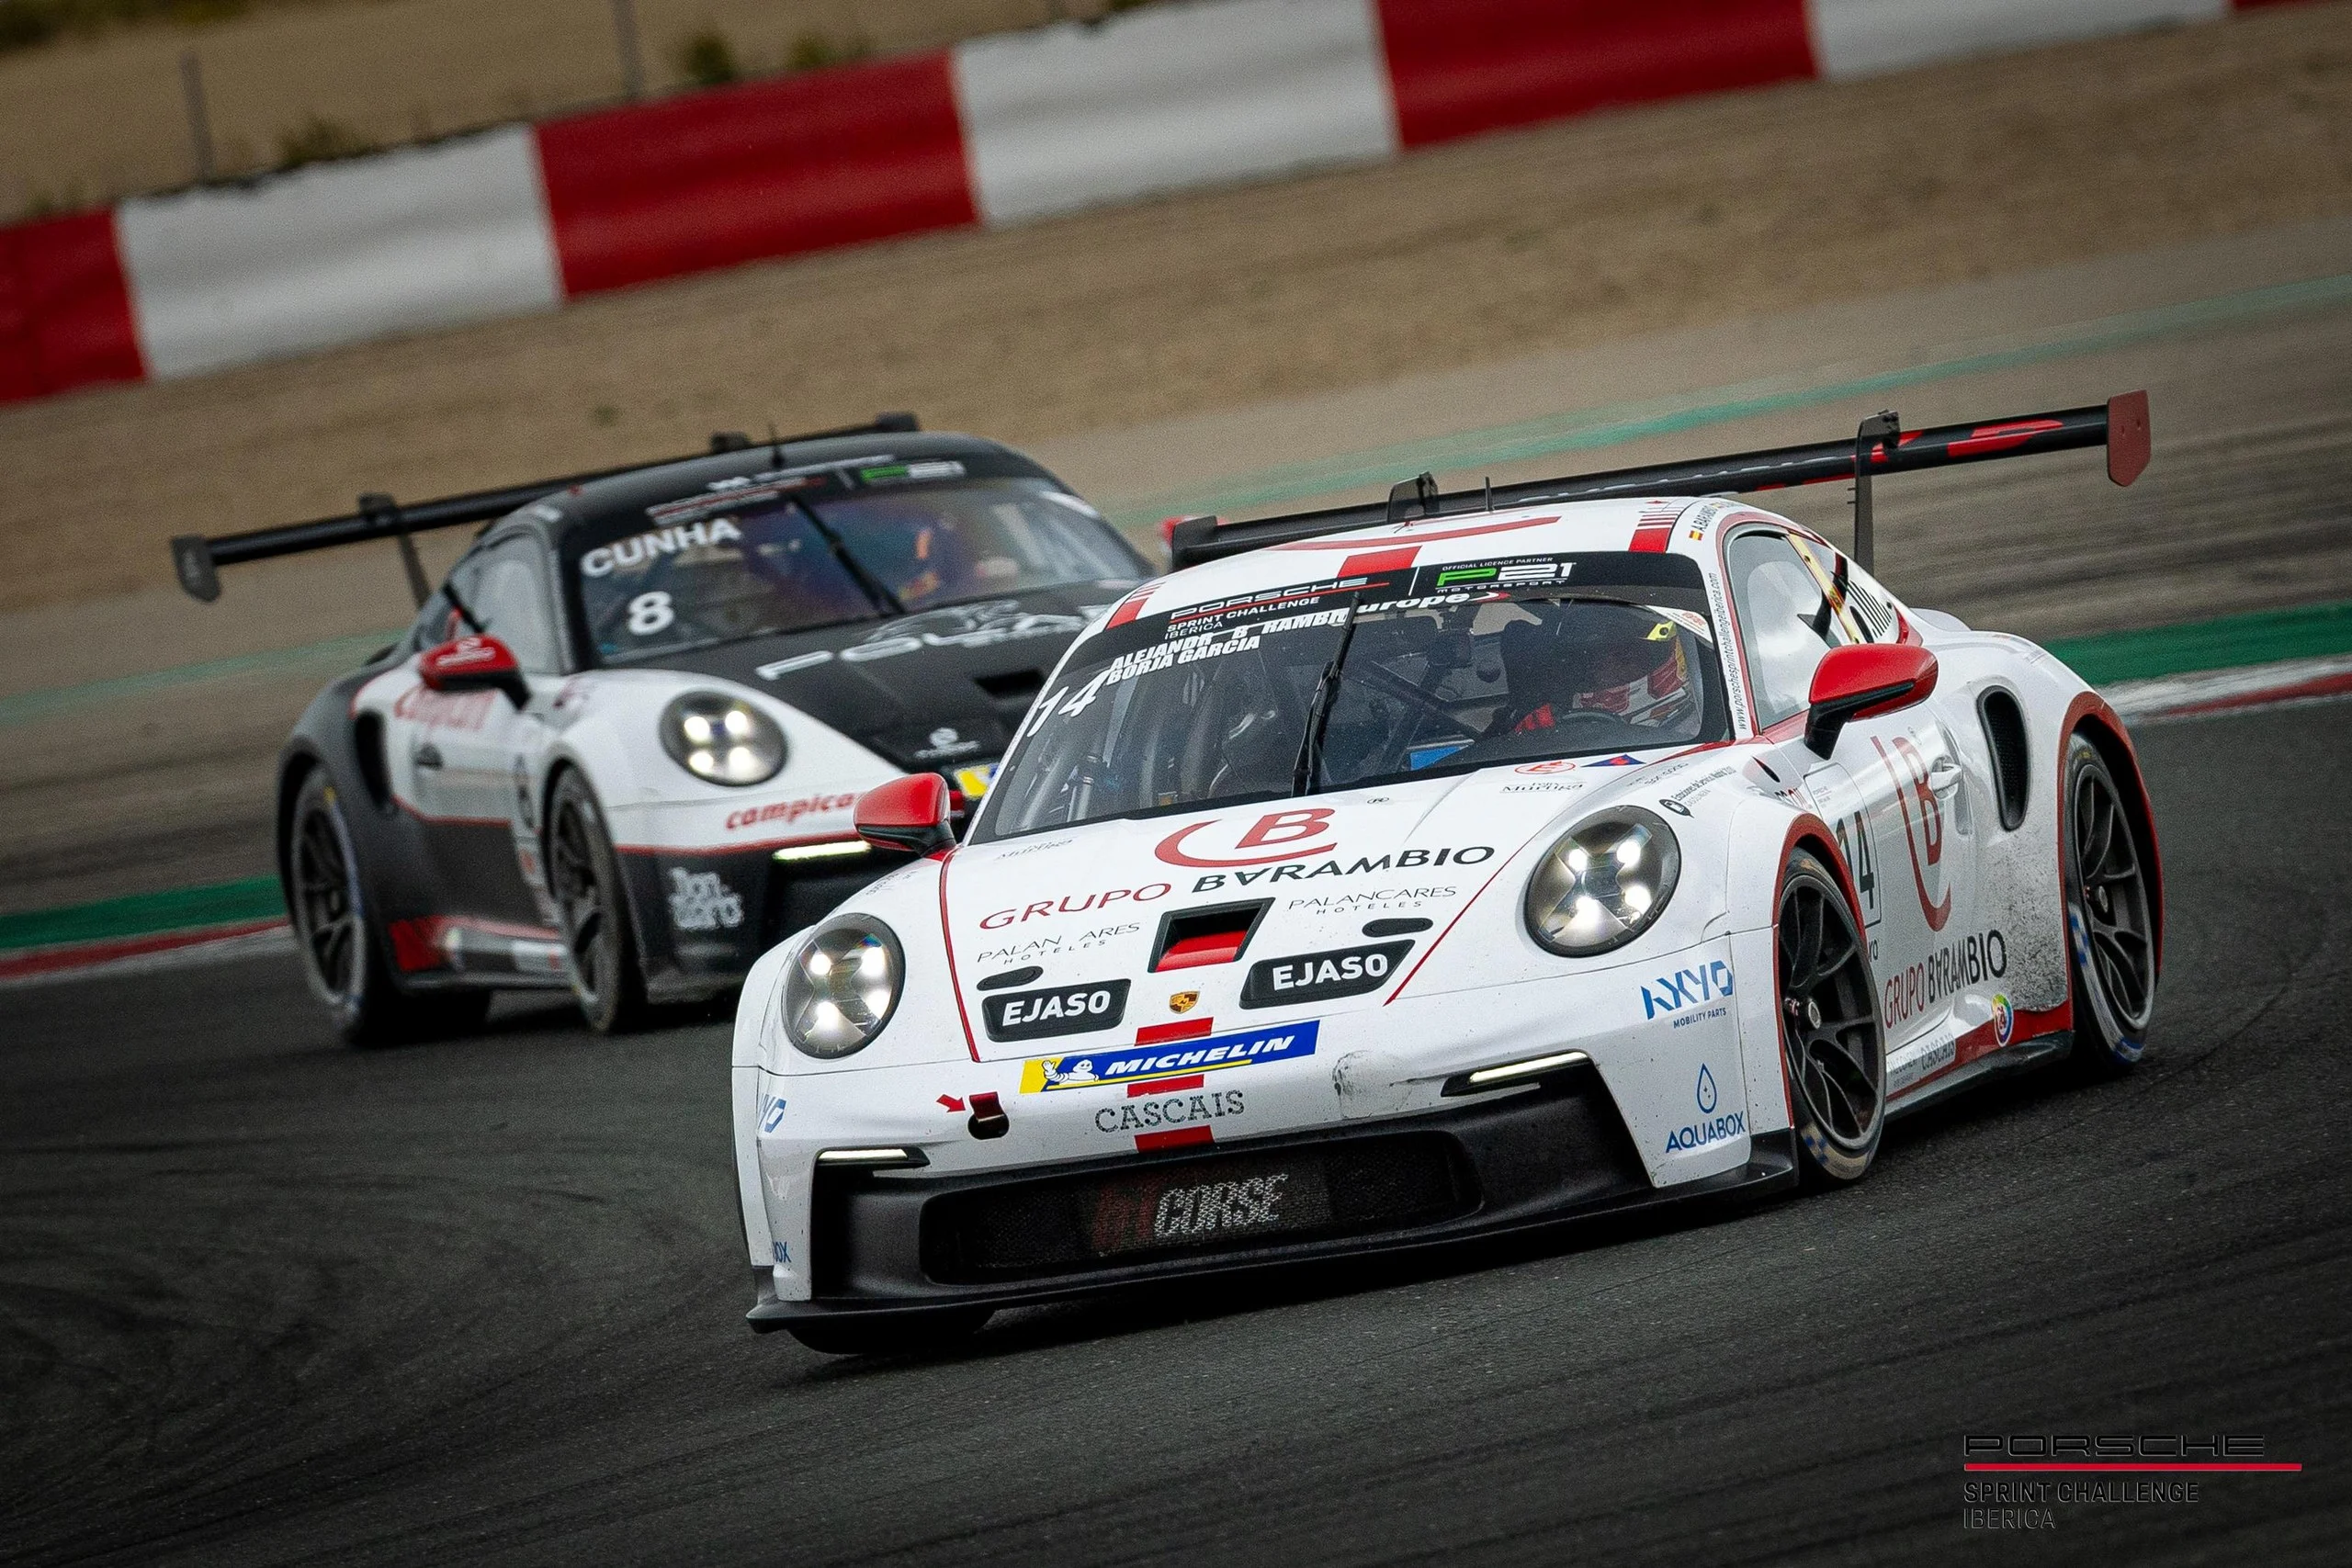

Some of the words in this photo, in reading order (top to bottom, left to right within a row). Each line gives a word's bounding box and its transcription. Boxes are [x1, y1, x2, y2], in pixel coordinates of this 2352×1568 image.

[580, 517, 741, 578] CUNHA
[1442, 563, 1477, 571] OFFICIAL
[1479, 559, 1514, 568] LICENCE
[1436, 562, 1577, 587] P21
[1437, 580, 1566, 593] MOTORSPORT
[626, 592, 674, 636] 8
[1167, 614, 1224, 632] SPRINT
[1227, 596, 1320, 619] CHALLENGE
[1170, 577, 1368, 619] PORSCHE
[1356, 592, 1470, 614] urope
[1164, 621, 1223, 640] IBERICA
[1107, 659, 1174, 685] BORJA
[1178, 636, 1260, 664] GARCIA
[1026, 668, 1111, 737] 14
[725, 794, 855, 831] campica
[979, 883, 1171, 930] GRUPO
[1288, 886, 1457, 910] PALANCARES
[1317, 901, 1422, 915] HOTELES
[1003, 939, 1106, 964] HOTELES
[1272, 953, 1389, 991] EJASO
[1001, 990, 1112, 1026] EJASO
[1884, 963, 1925, 1029] GRUPO
[1673, 1011, 1706, 1029] MOBILITY
[1707, 1007, 1727, 1019] PARTS
[1104, 1034, 1295, 1077] MICHELIN
[1094, 1089, 1245, 1134] CASCAIS
[1666, 1111, 1746, 1153] AQUABOX
[1154, 1173, 1289, 1237] CORSE
